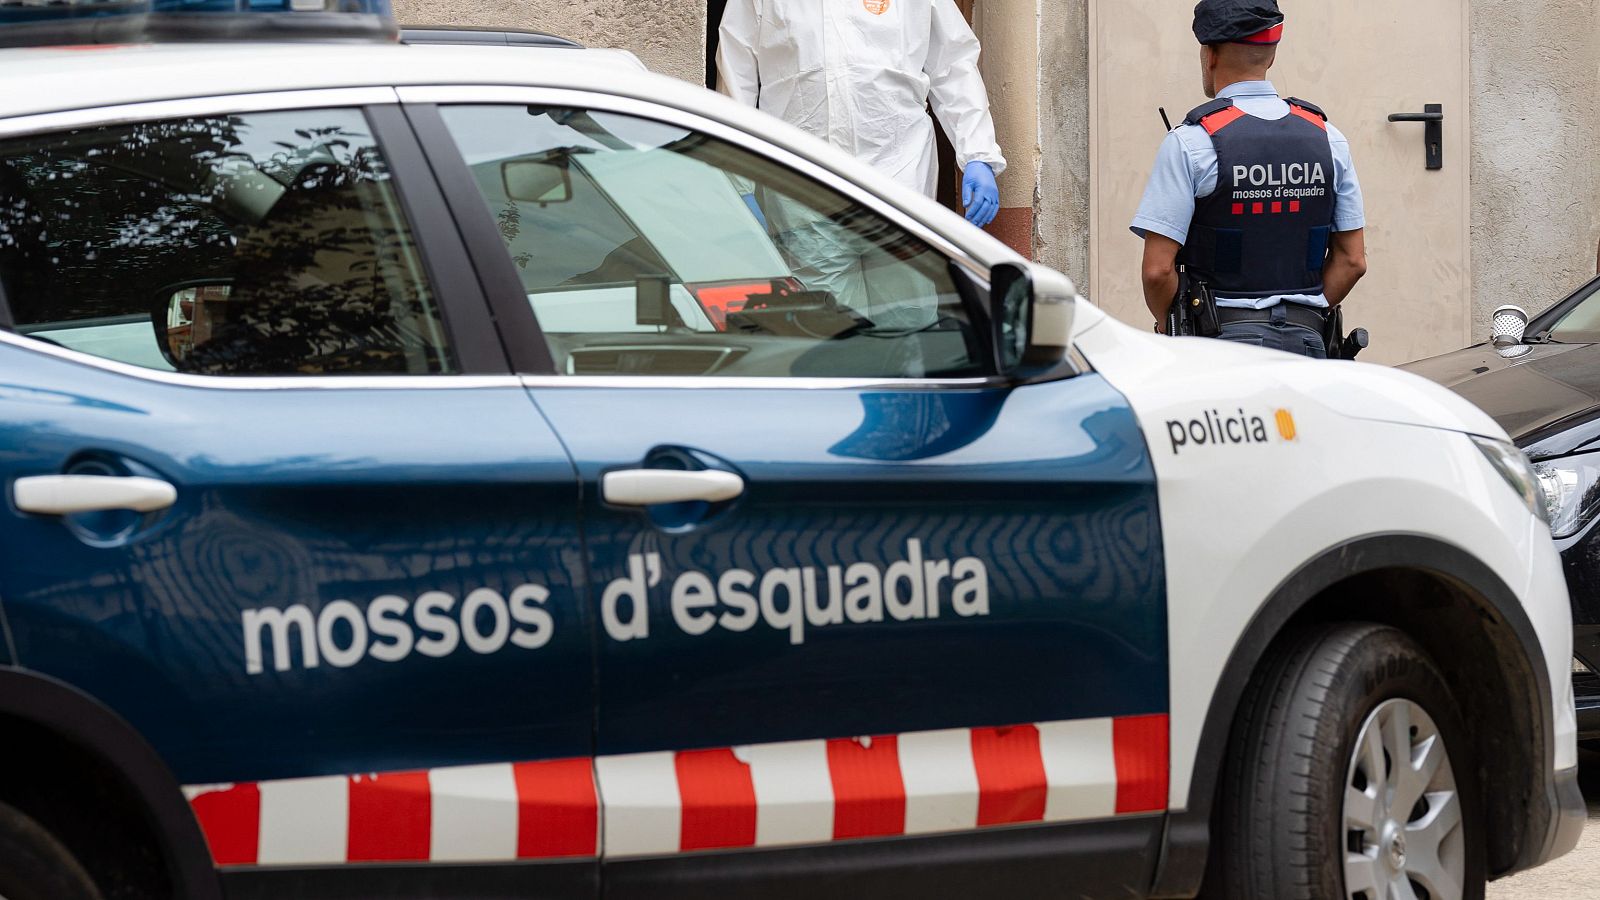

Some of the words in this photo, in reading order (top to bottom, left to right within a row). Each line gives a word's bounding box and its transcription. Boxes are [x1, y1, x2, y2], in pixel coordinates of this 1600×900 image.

[1233, 163, 1325, 187] POLICIA
[1232, 189, 1272, 199] mossos
[1166, 408, 1268, 454] policia
[242, 583, 554, 675] mossos
[601, 538, 989, 644] d’esquadra
